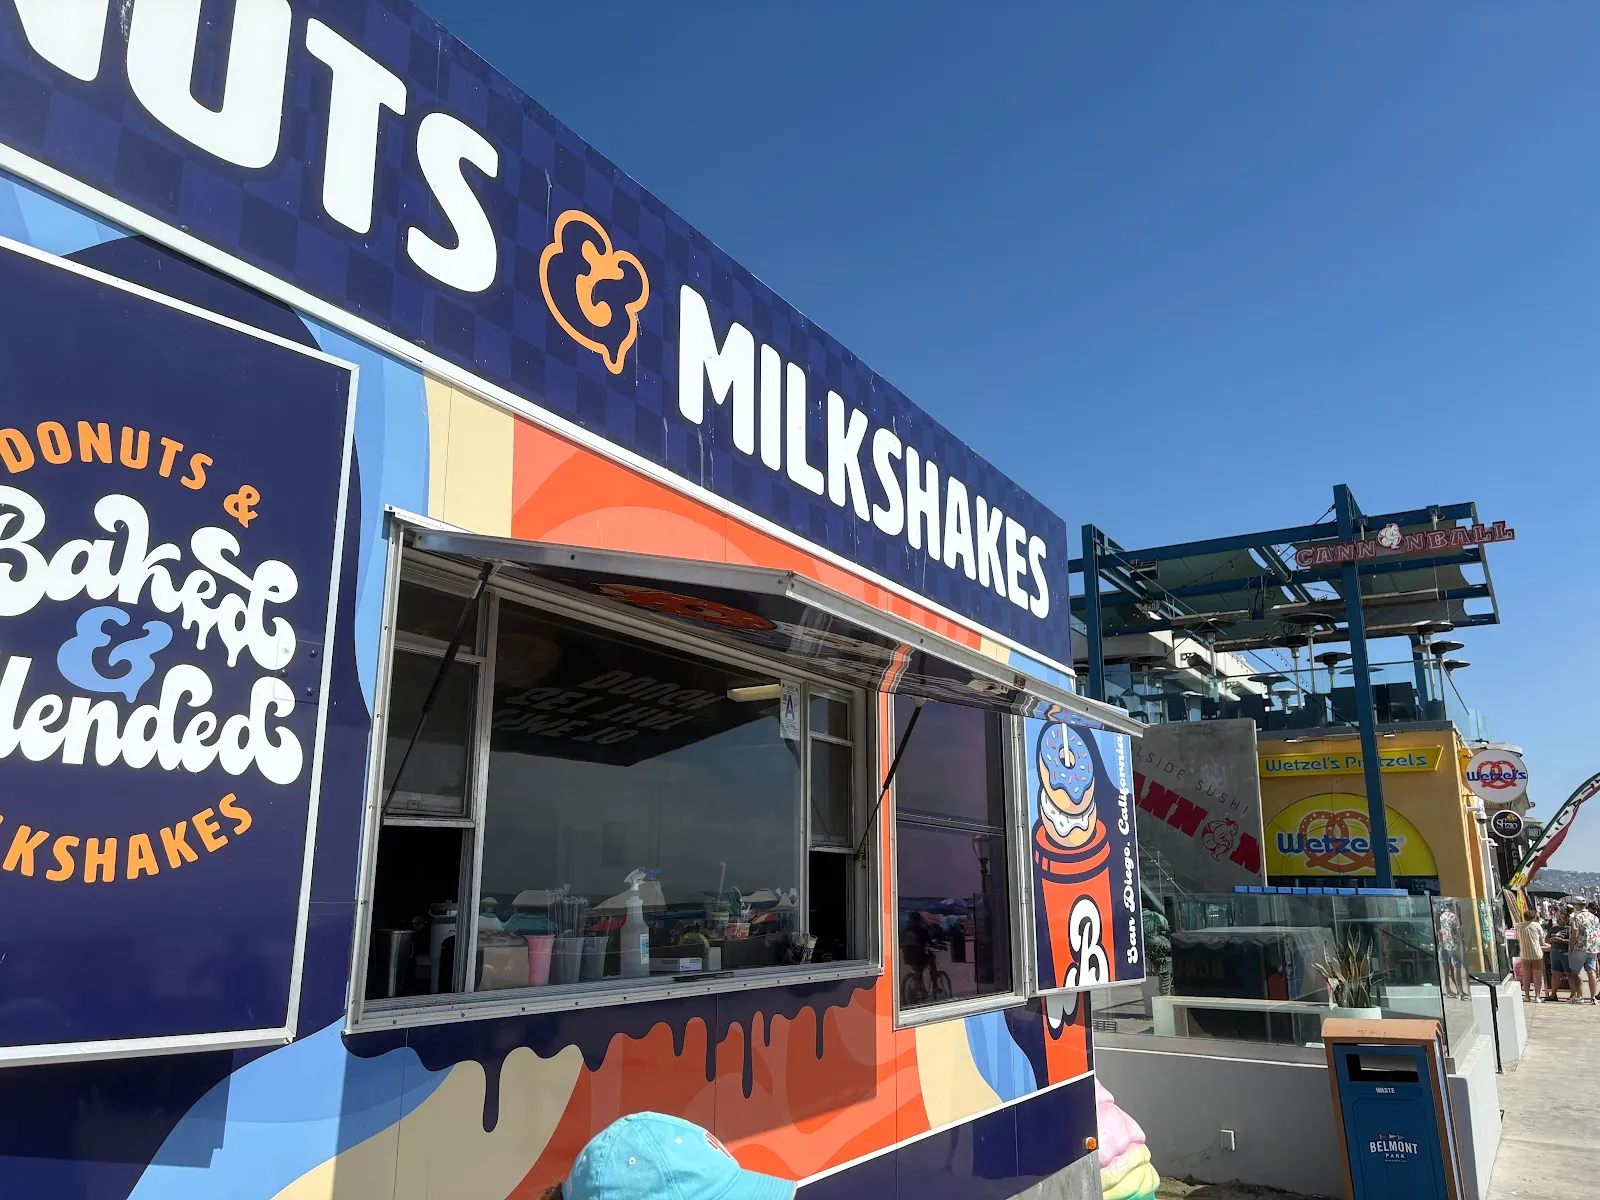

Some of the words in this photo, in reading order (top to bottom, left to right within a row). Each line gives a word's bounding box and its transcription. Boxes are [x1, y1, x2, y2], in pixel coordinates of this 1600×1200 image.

[14, 0, 499, 292] UTS
[678, 284, 1050, 618] MILKSHAKES
[0, 420, 214, 490] DONUTS
[223, 485, 260, 528] &
[1296, 520, 1516, 567] CANNNBALL
[57, 605, 174, 703] &
[785, 695, 796, 720] A
[1117, 734, 1130, 836] California
[1265, 757, 1341, 772] Wetzel's
[1345, 753, 1428, 769] Prtzels
[1467, 770, 1527, 782] Wetzel's
[1195, 779, 1249, 815] SUSHI
[0, 792, 253, 884] KSHAKES
[1127, 916, 1139, 964] San
[1369, 1141, 1418, 1154] BELMONT
